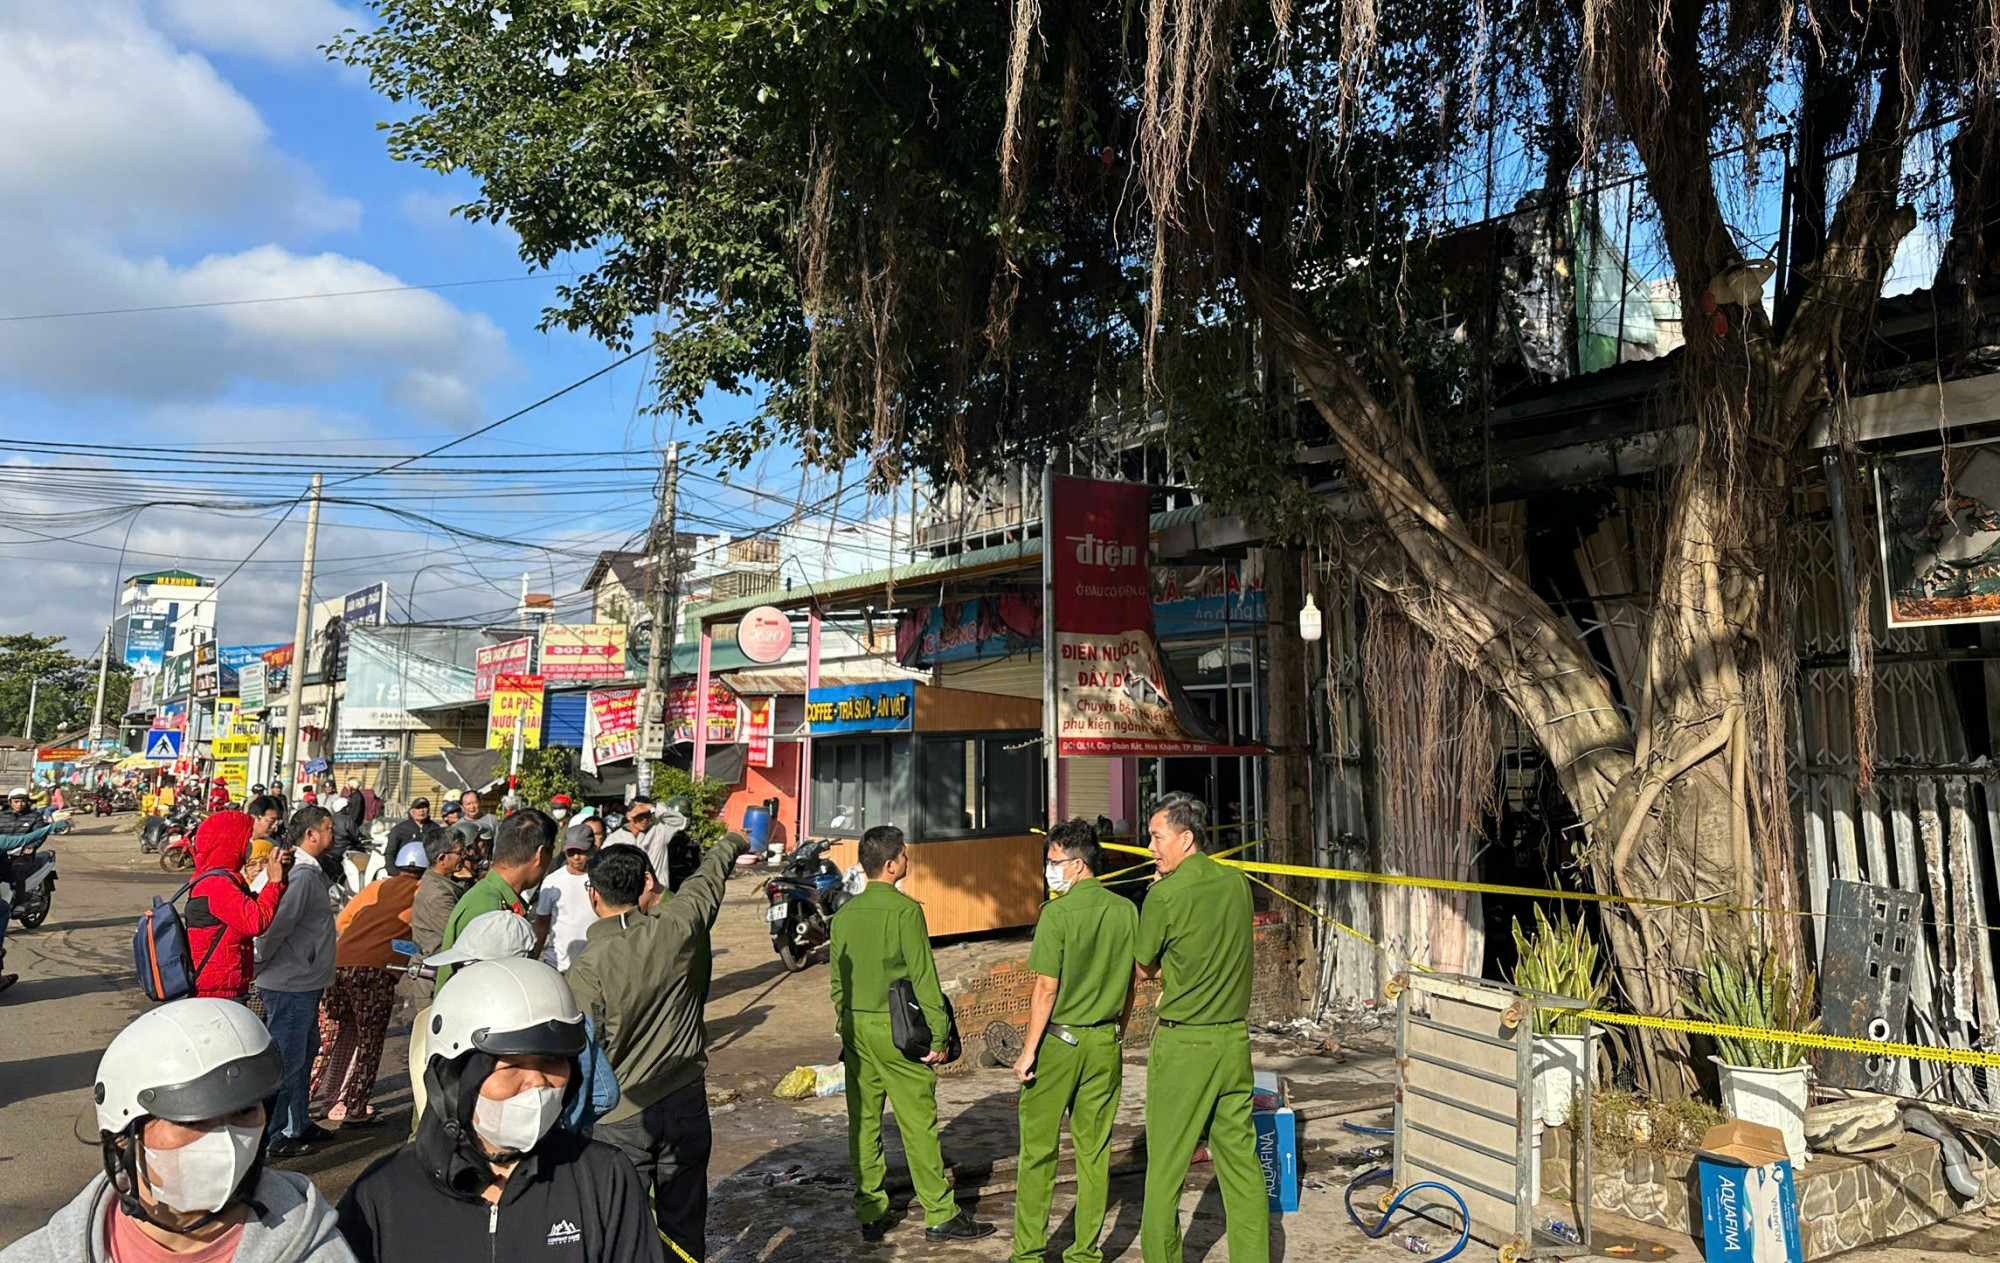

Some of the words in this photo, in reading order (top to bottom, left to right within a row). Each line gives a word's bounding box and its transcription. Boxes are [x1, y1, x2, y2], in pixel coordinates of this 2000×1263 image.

[1065, 533, 1137, 571] điện
[157, 576, 197, 587] MAXHOME
[1062, 642, 1097, 665] ĐIỆN
[1102, 638, 1139, 662] NƯỚC
[1078, 665, 1108, 687] ĐẦY
[501, 695, 513, 709] CÀ
[516, 696, 534, 709] PHÊ
[807, 703, 833, 721] COFFEE
[839, 697, 853, 720] TRÀ
[855, 696, 871, 719] SỮA
[877, 693, 888, 717] ĂN
[891, 693, 906, 719] VẶT
[1077, 699, 1115, 714] Chuyên
[1120, 699, 1137, 716] bán
[1063, 717, 1085, 733] phụ
[1088, 717, 1110, 733] kiện
[1114, 719, 1148, 734] ngành
[1259, 1130, 1277, 1198] AQUAFINA
[1718, 1174, 1741, 1252] AQUAFINA
